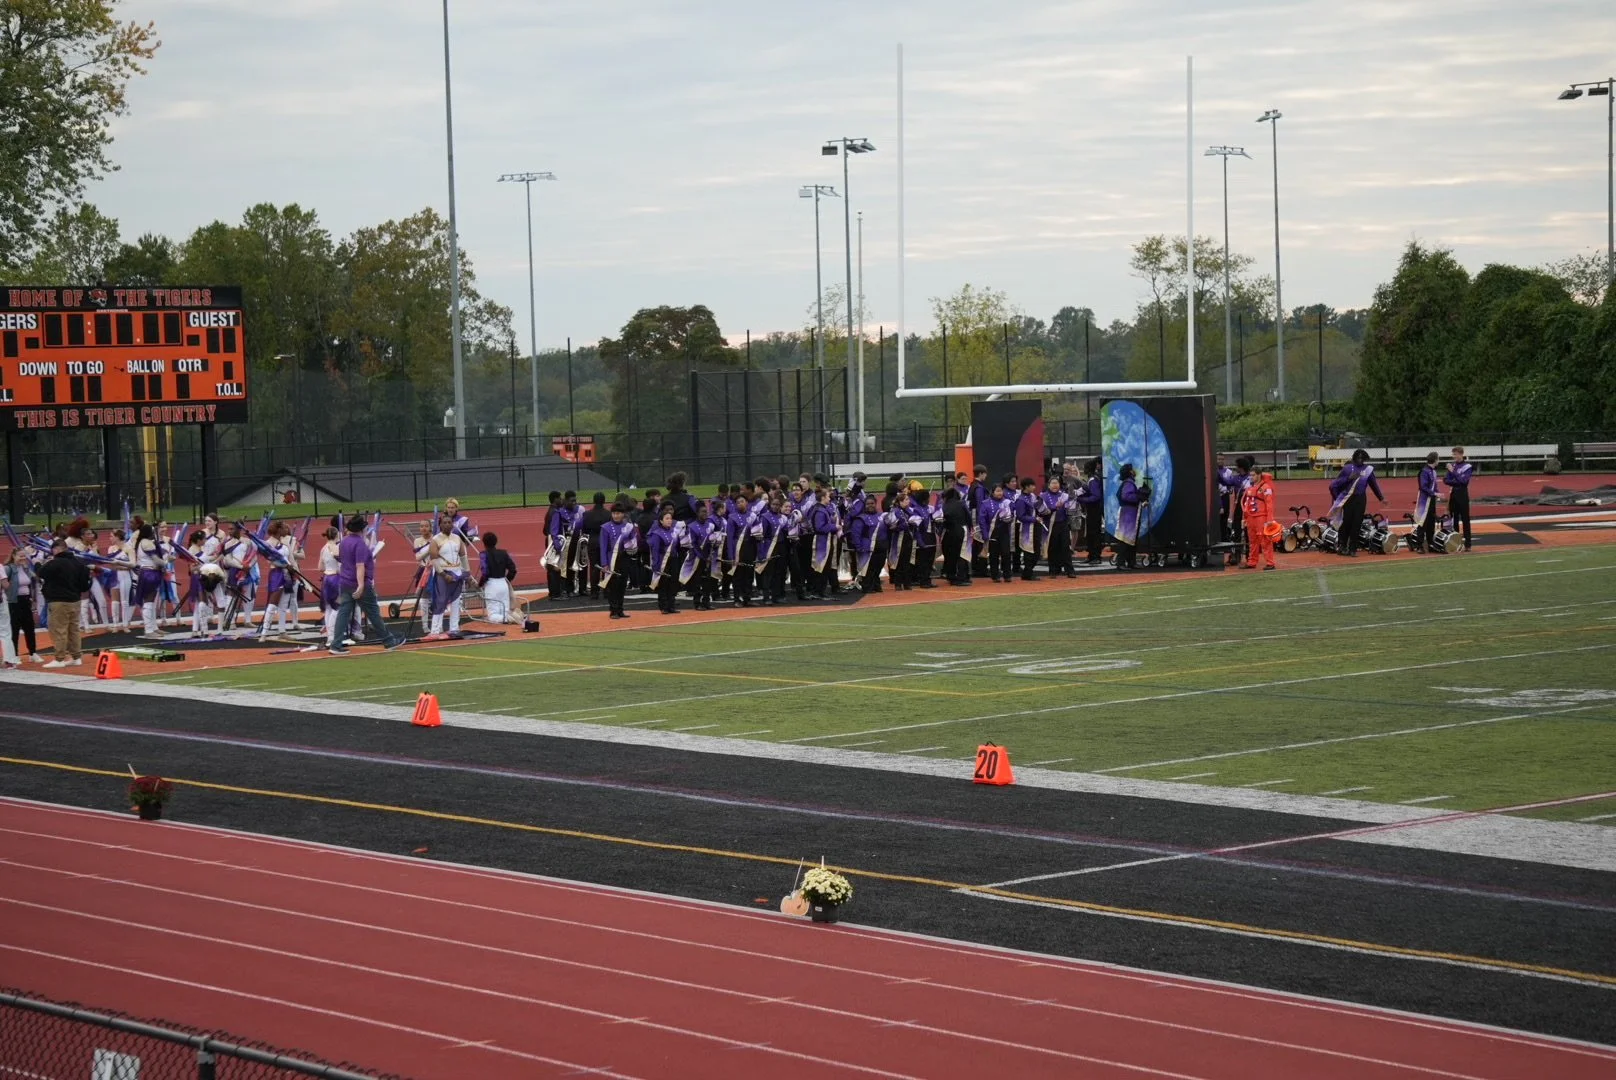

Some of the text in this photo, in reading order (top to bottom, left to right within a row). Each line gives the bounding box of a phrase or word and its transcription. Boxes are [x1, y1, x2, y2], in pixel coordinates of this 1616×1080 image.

[9, 289, 211, 307] HOME OF THE TIGERS
[189, 312, 235, 327] GUEST
[19, 362, 57, 376] DOWN
[66, 360, 104, 375] TO GO
[127, 359, 165, 374] BALL ON
[178, 359, 202, 372] QTR
[216, 383, 242, 396] T.O.L.
[15, 405, 216, 428] THIS IS TIGER COUNTRY
[98, 655, 108, 675] G
[414, 697, 429, 721] 10
[974, 749, 999, 780] 20
